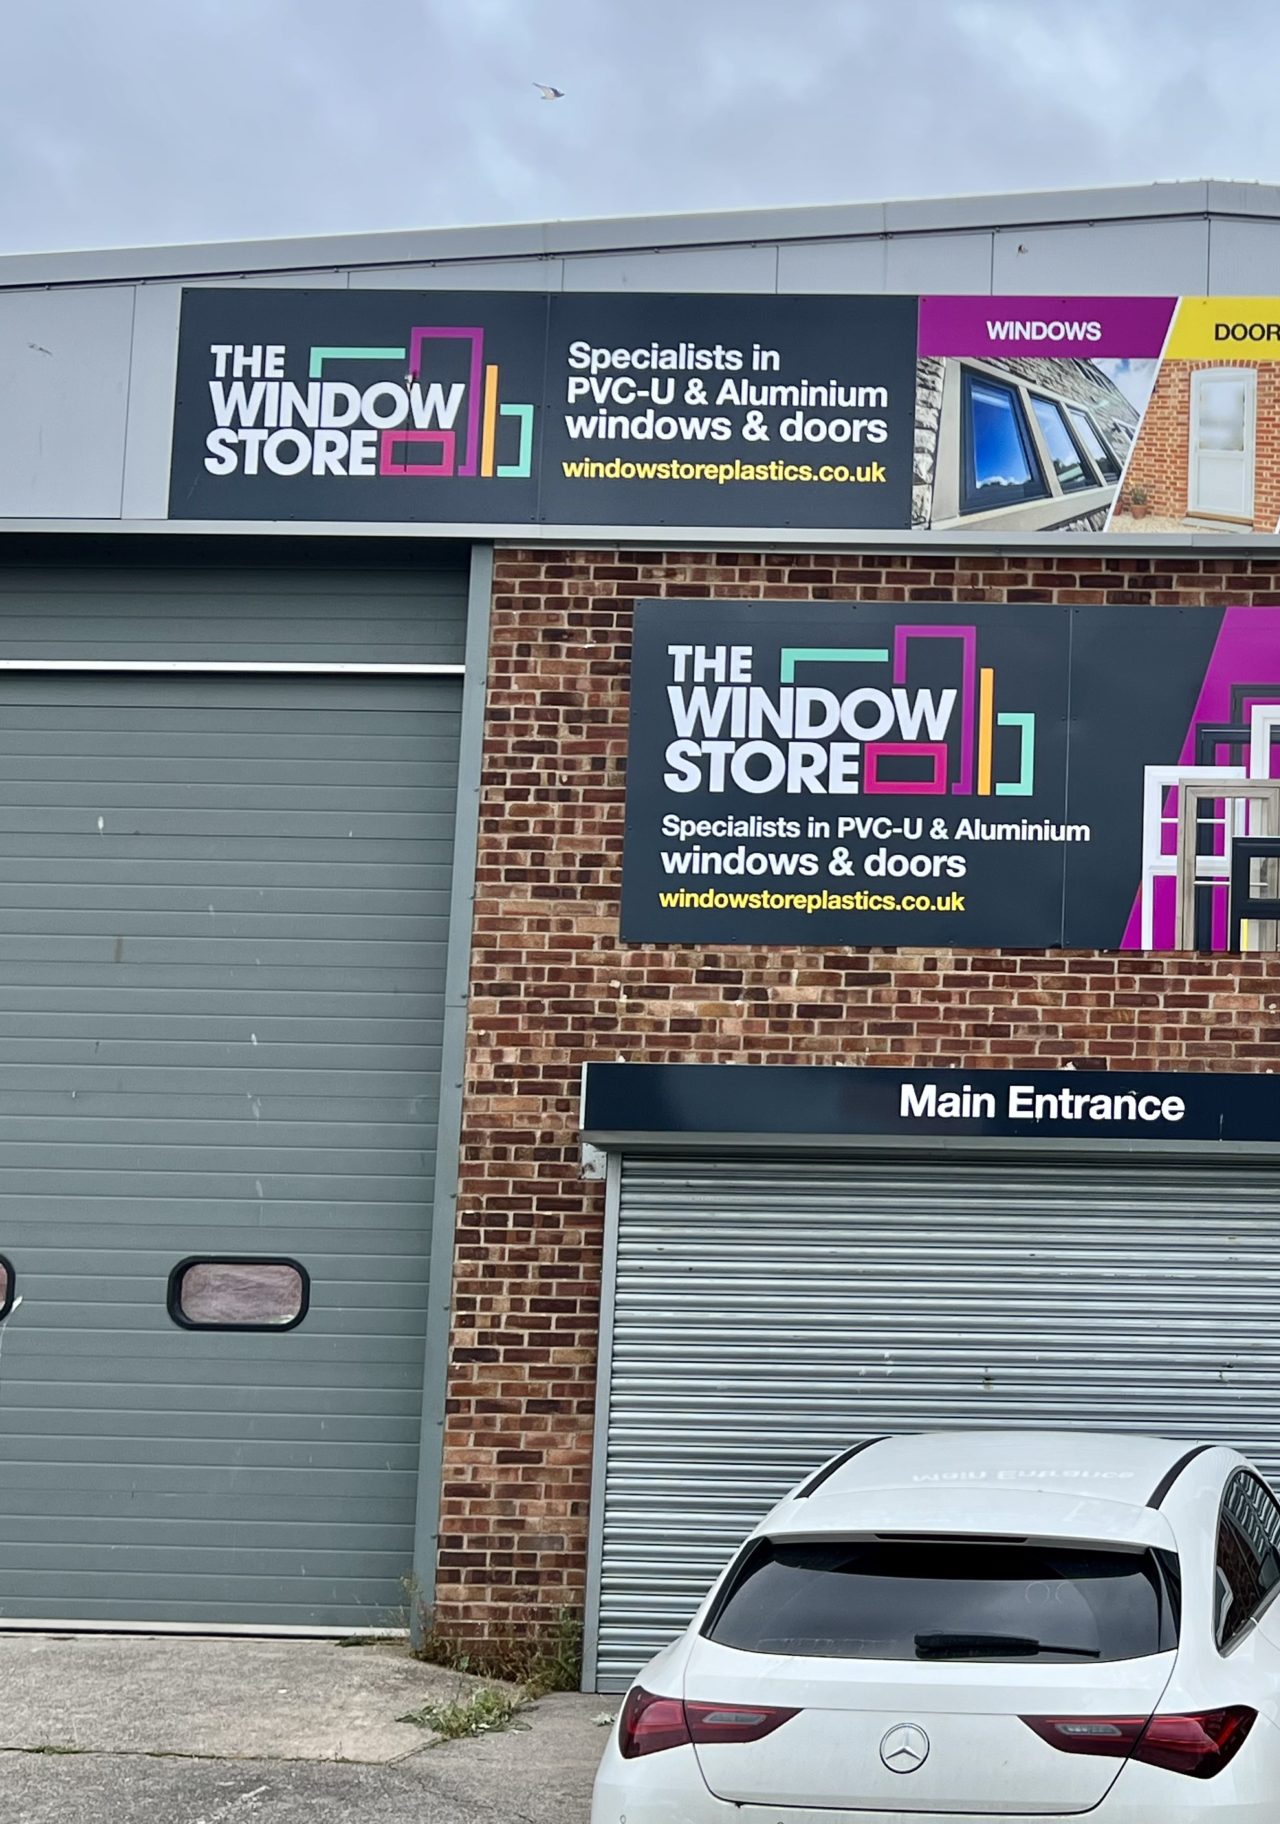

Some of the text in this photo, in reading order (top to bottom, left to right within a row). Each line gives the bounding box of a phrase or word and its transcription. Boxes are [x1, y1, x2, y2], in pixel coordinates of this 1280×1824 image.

[986, 320, 1102, 341] WINDOWS
[210, 344, 286, 378] THE
[568, 341, 780, 375] Specialists in
[208, 380, 466, 430] WINDOW
[567, 376, 888, 408] PVC-U & Aluminium
[564, 408, 888, 444] windows & doors
[204, 429, 378, 476] STORE
[562, 456, 887, 485] windowstoreplastics.co.uk
[667, 645, 753, 683] THE
[666, 685, 958, 741] WINDOW
[663, 739, 860, 794] STORE
[661, 814, 1091, 842] Specialists in PVC-U & Aluminium
[660, 844, 967, 878] windows & doors
[658, 888, 966, 914] windowstoreplastics.co.uk
[900, 1083, 1186, 1121] Main Entrance
